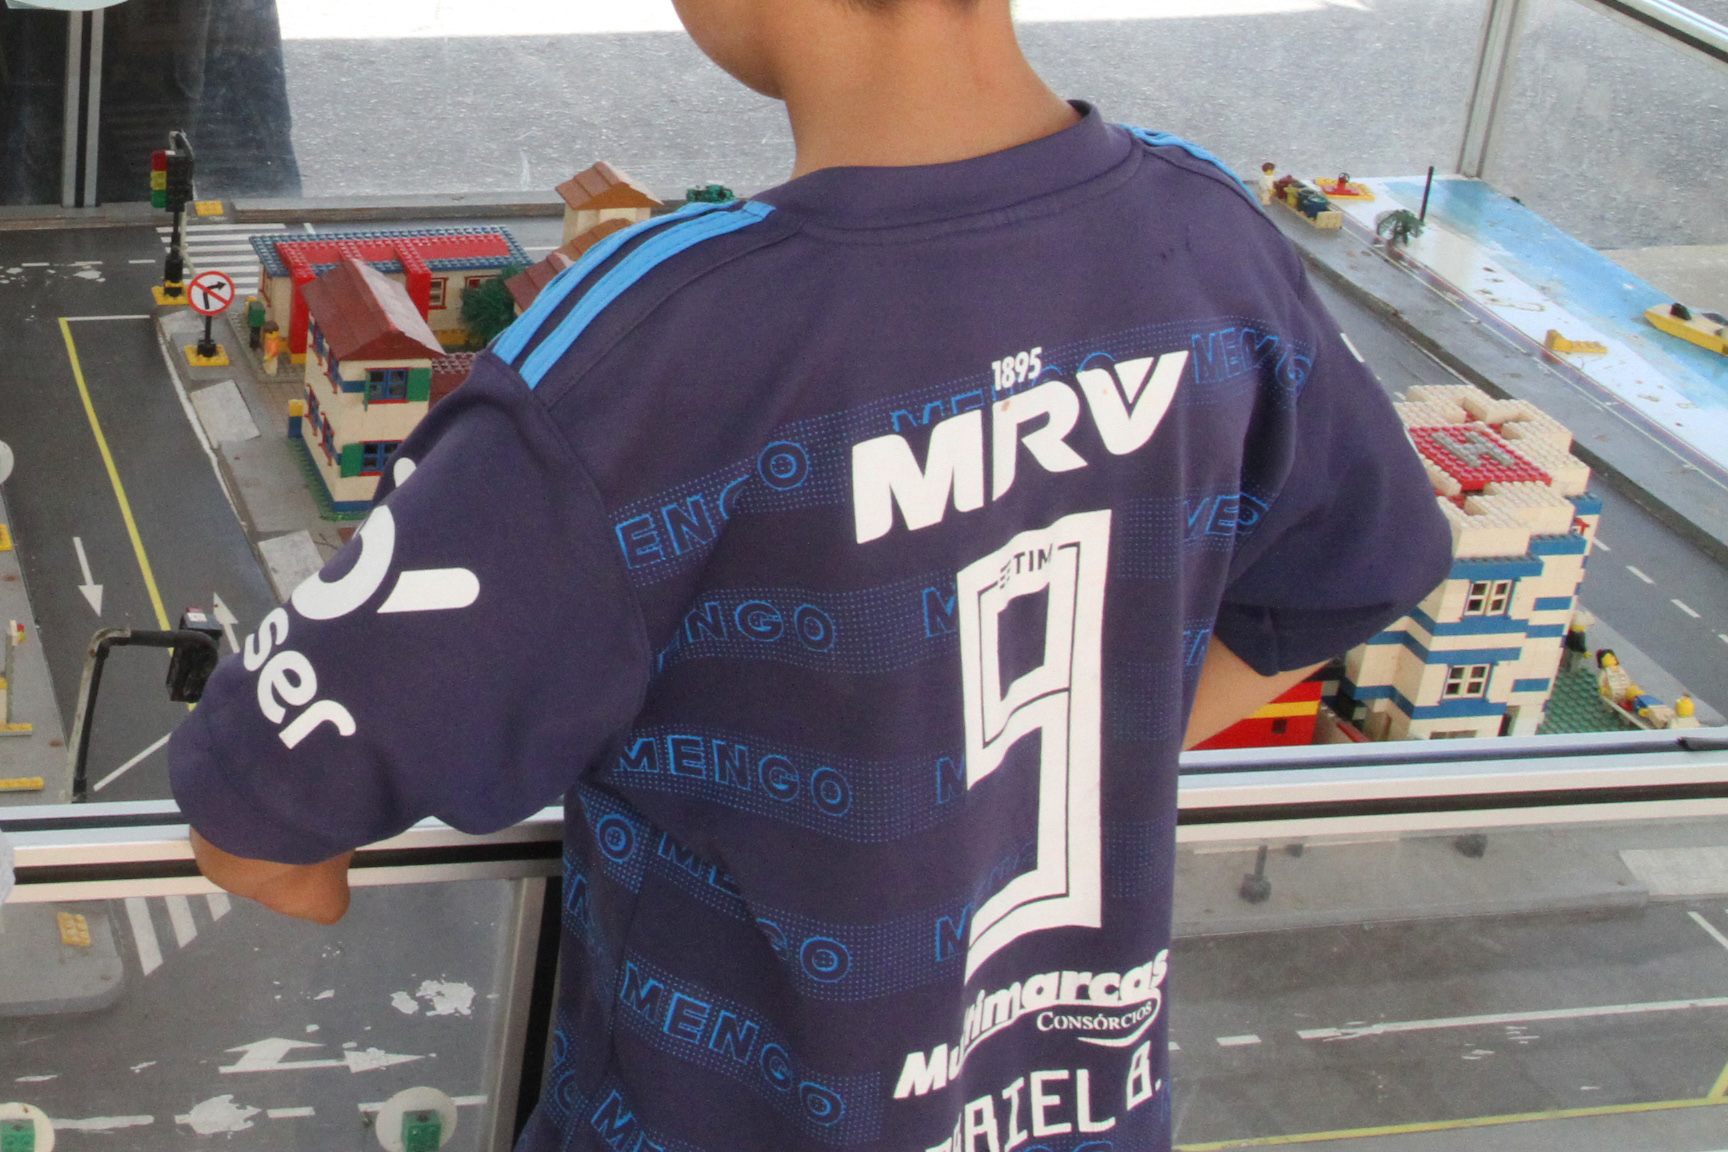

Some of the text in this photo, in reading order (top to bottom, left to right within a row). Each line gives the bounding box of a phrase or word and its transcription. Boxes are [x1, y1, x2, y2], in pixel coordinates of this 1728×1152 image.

[851, 349, 1189, 545] MRV
[991, 346, 1043, 391] 1895
[614, 734, 854, 818] MENGO
[956, 508, 1113, 986] 9
[619, 961, 847, 1127] MENGO
